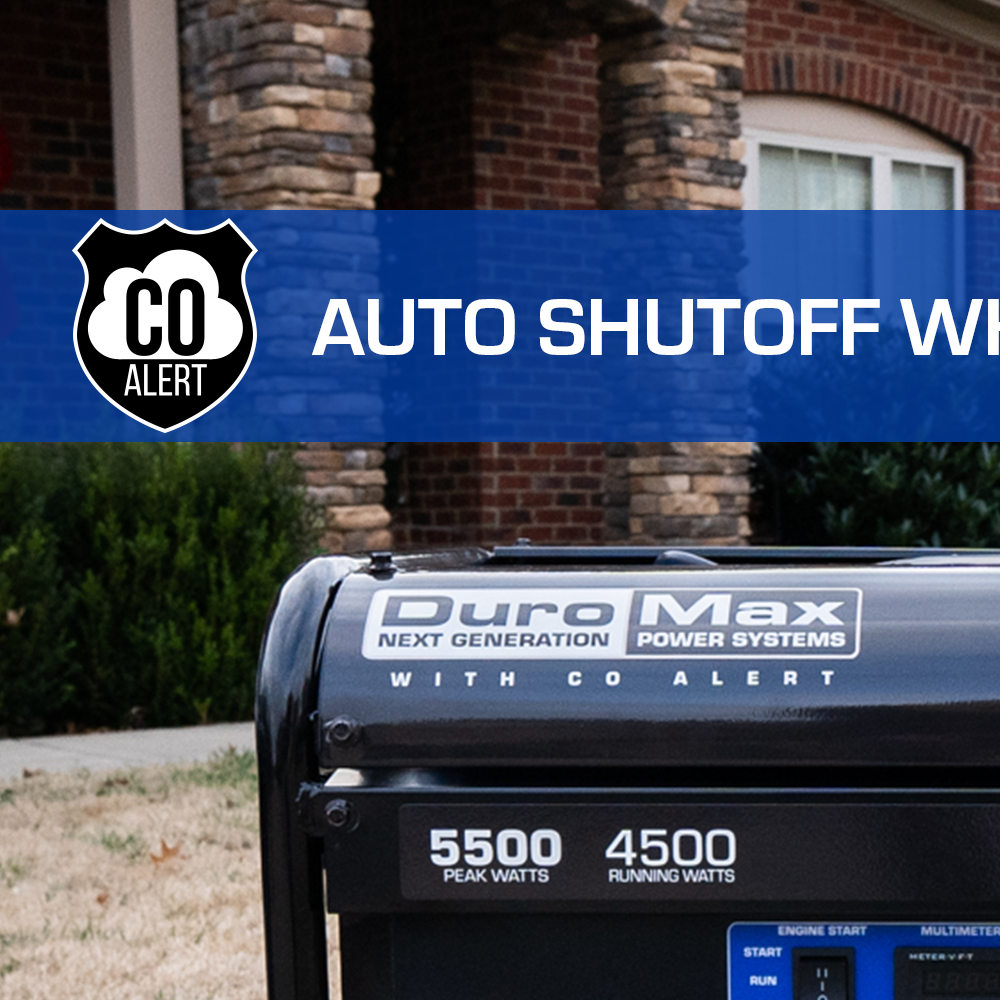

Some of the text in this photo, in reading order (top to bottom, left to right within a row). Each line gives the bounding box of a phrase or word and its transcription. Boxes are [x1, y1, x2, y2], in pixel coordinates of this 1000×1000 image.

[378, 632, 610, 648] NEXT GENERATION
[637, 631, 846, 648] POWER SYSTEMS
[391, 670, 835, 688] WITH CO ALERT
[429, 828, 562, 867] 5500
[605, 828, 737, 867] 4500
[443, 868, 550, 883] PEAK WATTS
[608, 868, 736, 883] RUNNING WATTS
[777, 925, 868, 937] ENGINE START
[743, 946, 783, 958] START
[749, 975, 778, 987] RUN
